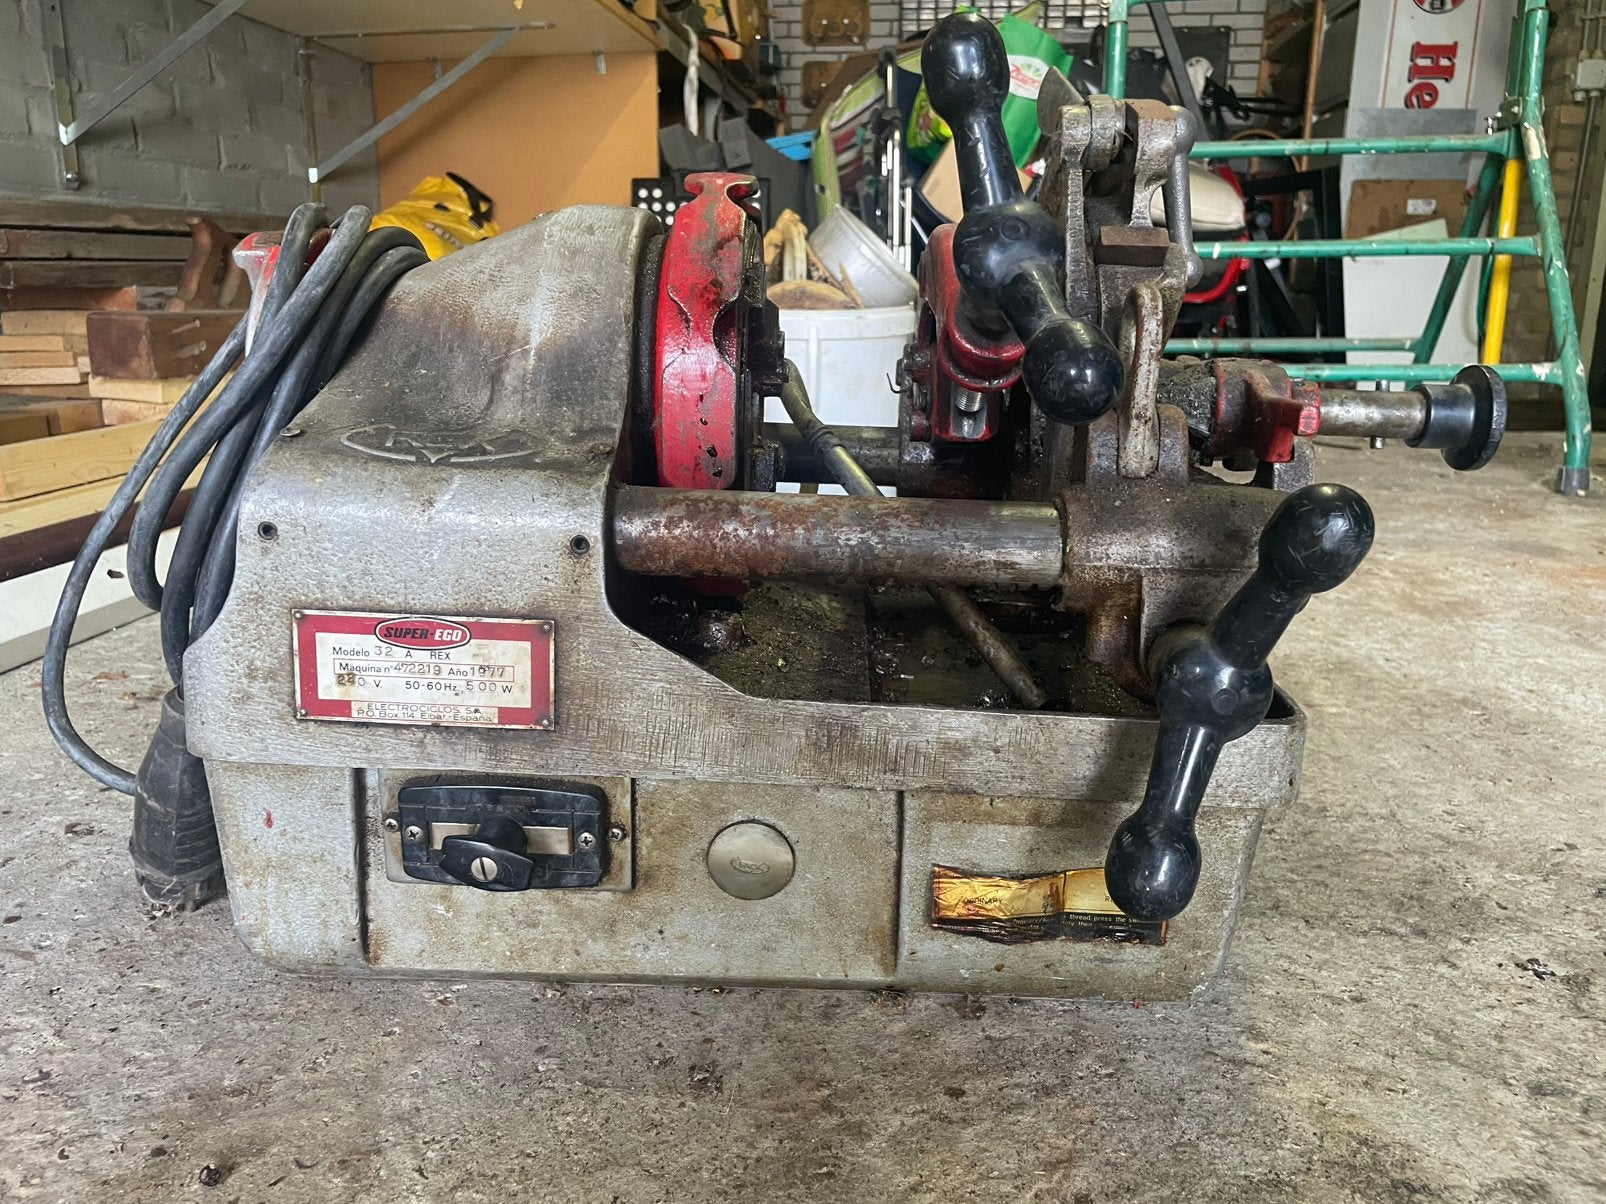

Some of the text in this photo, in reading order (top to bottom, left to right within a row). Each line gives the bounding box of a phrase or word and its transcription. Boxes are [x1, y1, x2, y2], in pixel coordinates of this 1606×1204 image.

[383, 626, 462, 641] SUPER-EGO
[332, 645, 451, 661] Modelo 32 A REX
[393, 661, 442, 675] 472219
[447, 666, 468, 678] Año
[470, 664, 505, 677] 1977
[405, 680, 443, 691] 50-60
[466, 680, 497, 692] 500
[379, 710, 399, 719] Box
